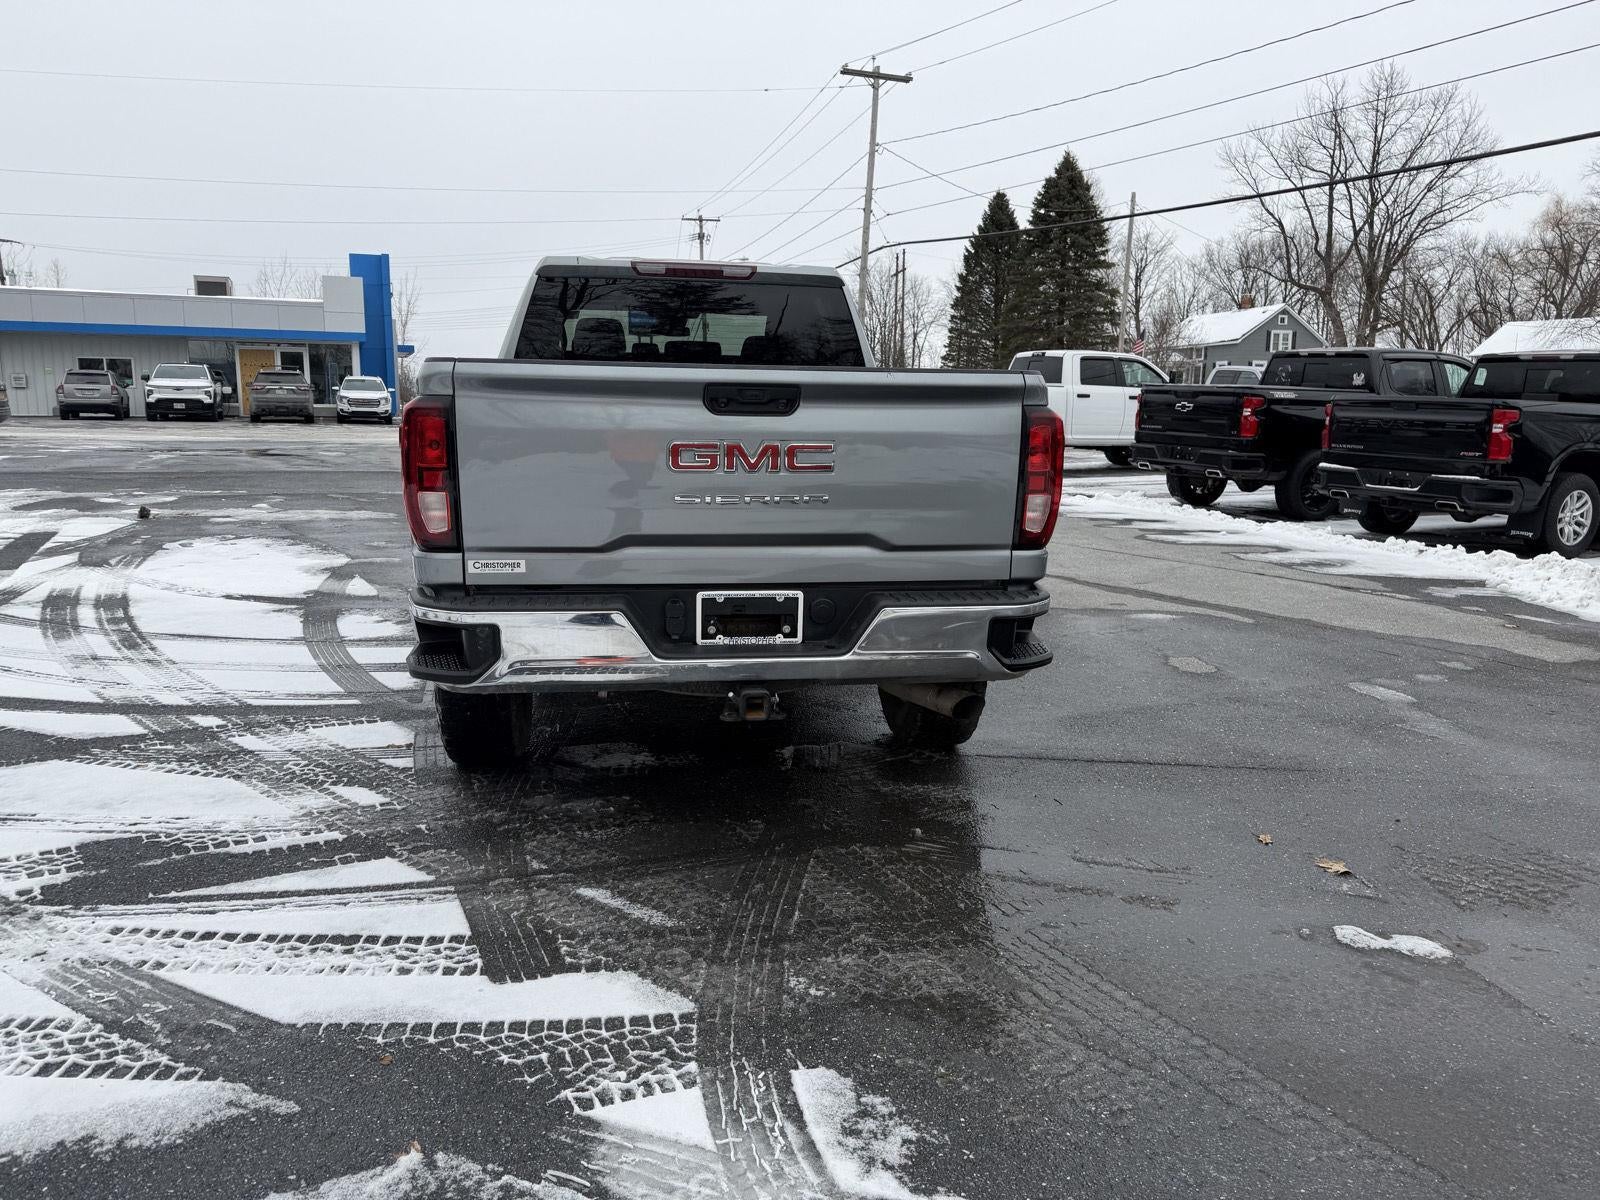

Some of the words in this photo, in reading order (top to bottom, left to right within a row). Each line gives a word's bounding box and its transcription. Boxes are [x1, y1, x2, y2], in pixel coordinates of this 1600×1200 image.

[668, 441, 835, 473] GMC
[674, 493, 830, 505] SIERRA
[723, 636, 776, 645] CHRISTOPHER
